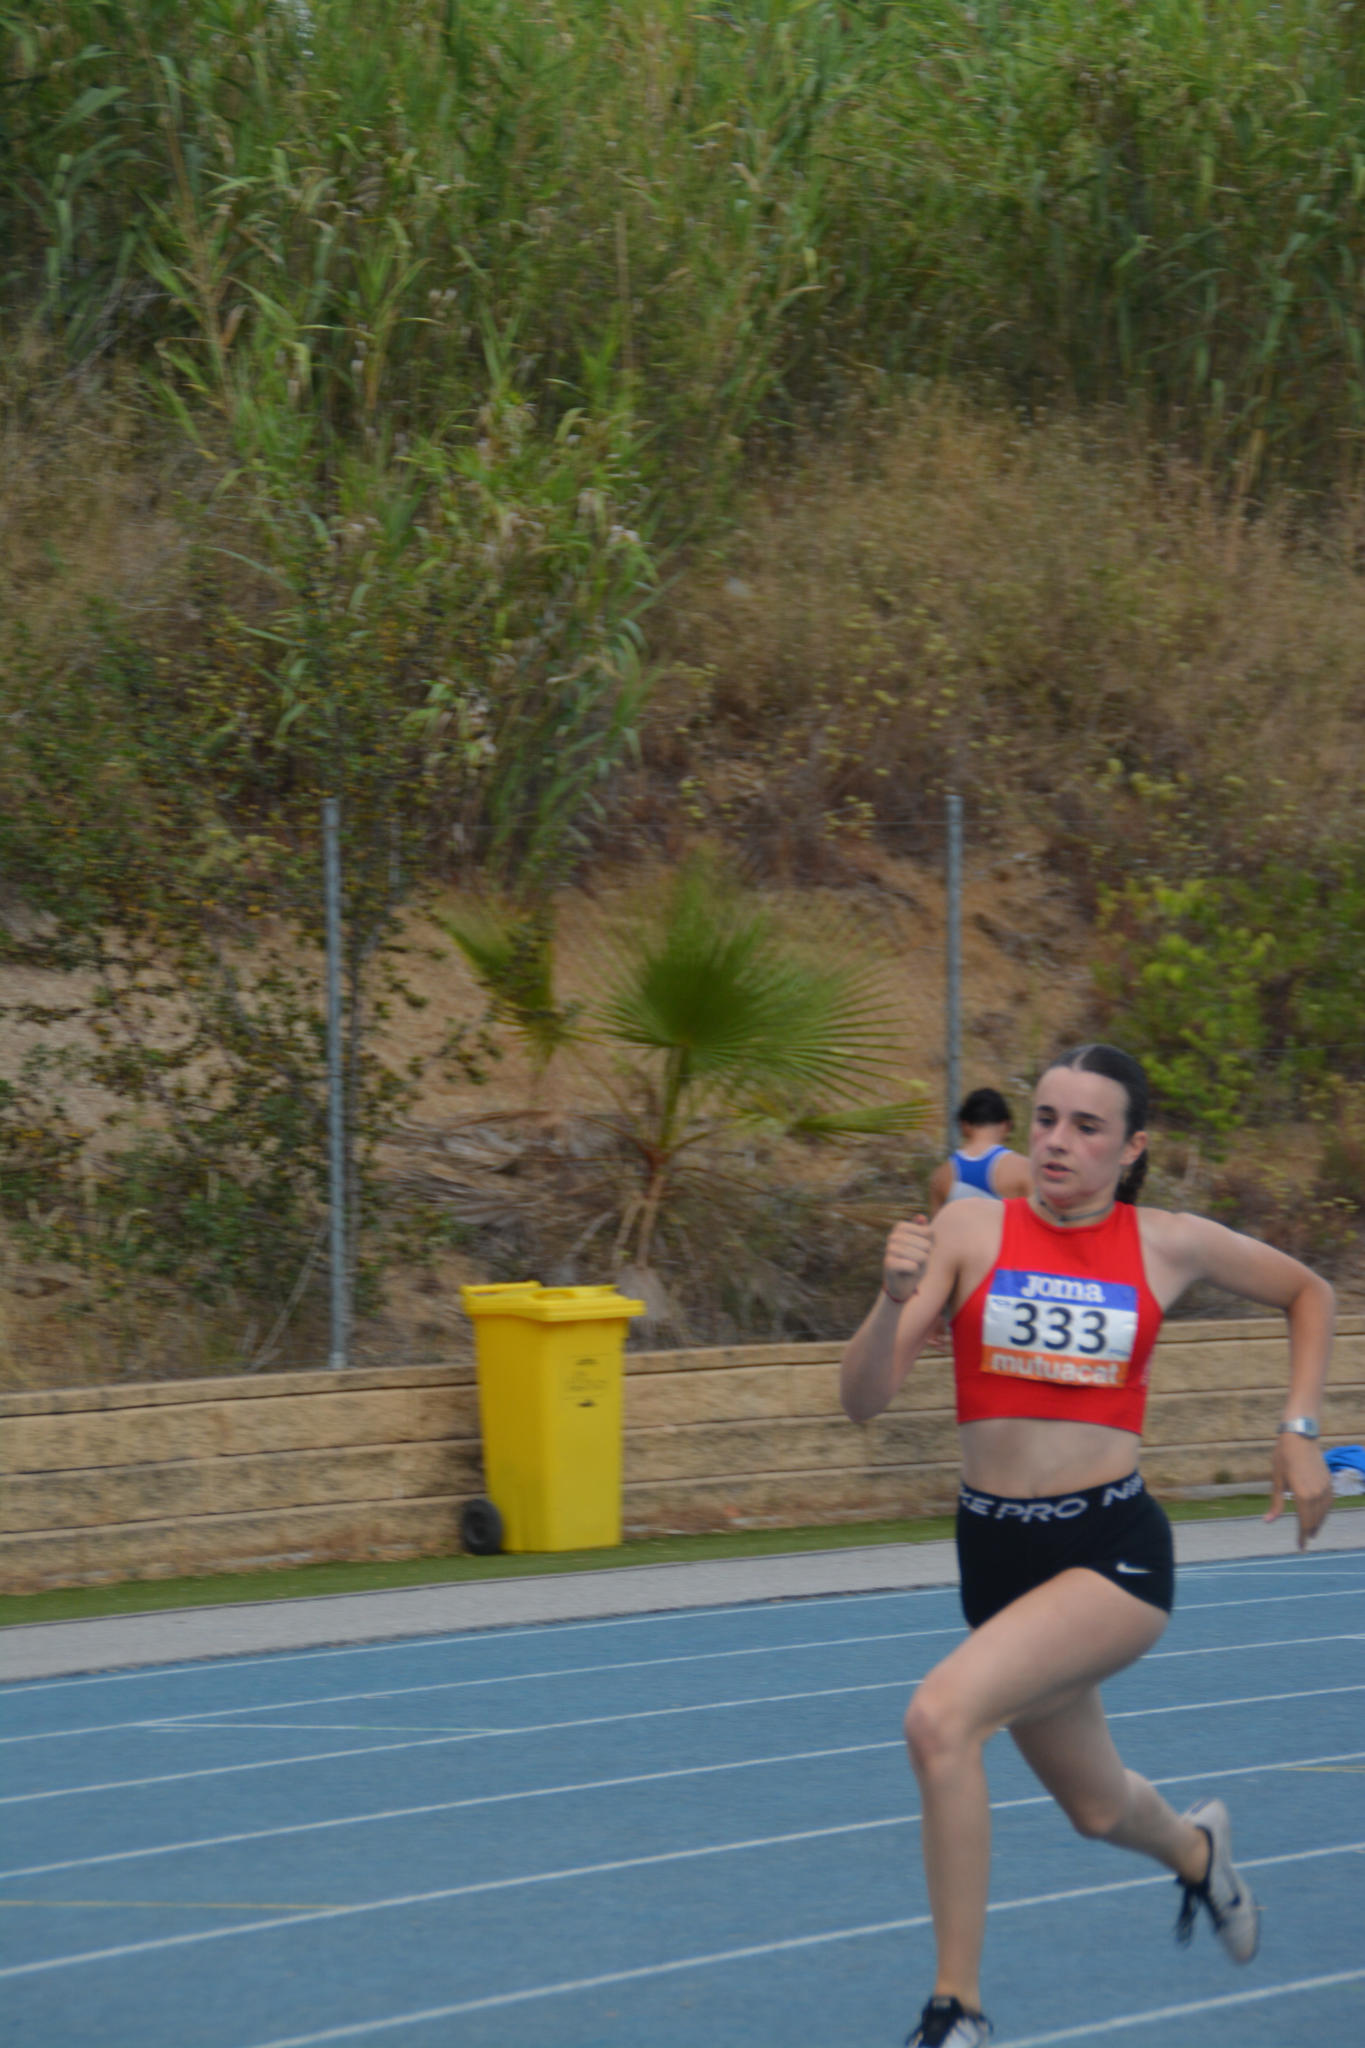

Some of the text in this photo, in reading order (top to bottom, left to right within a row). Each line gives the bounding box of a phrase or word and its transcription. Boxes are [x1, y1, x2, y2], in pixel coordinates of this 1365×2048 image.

[1009, 1302, 1107, 1354] 333
[991, 1352, 1120, 1384] mutuacat
[994, 1498, 1088, 1523] PRO
